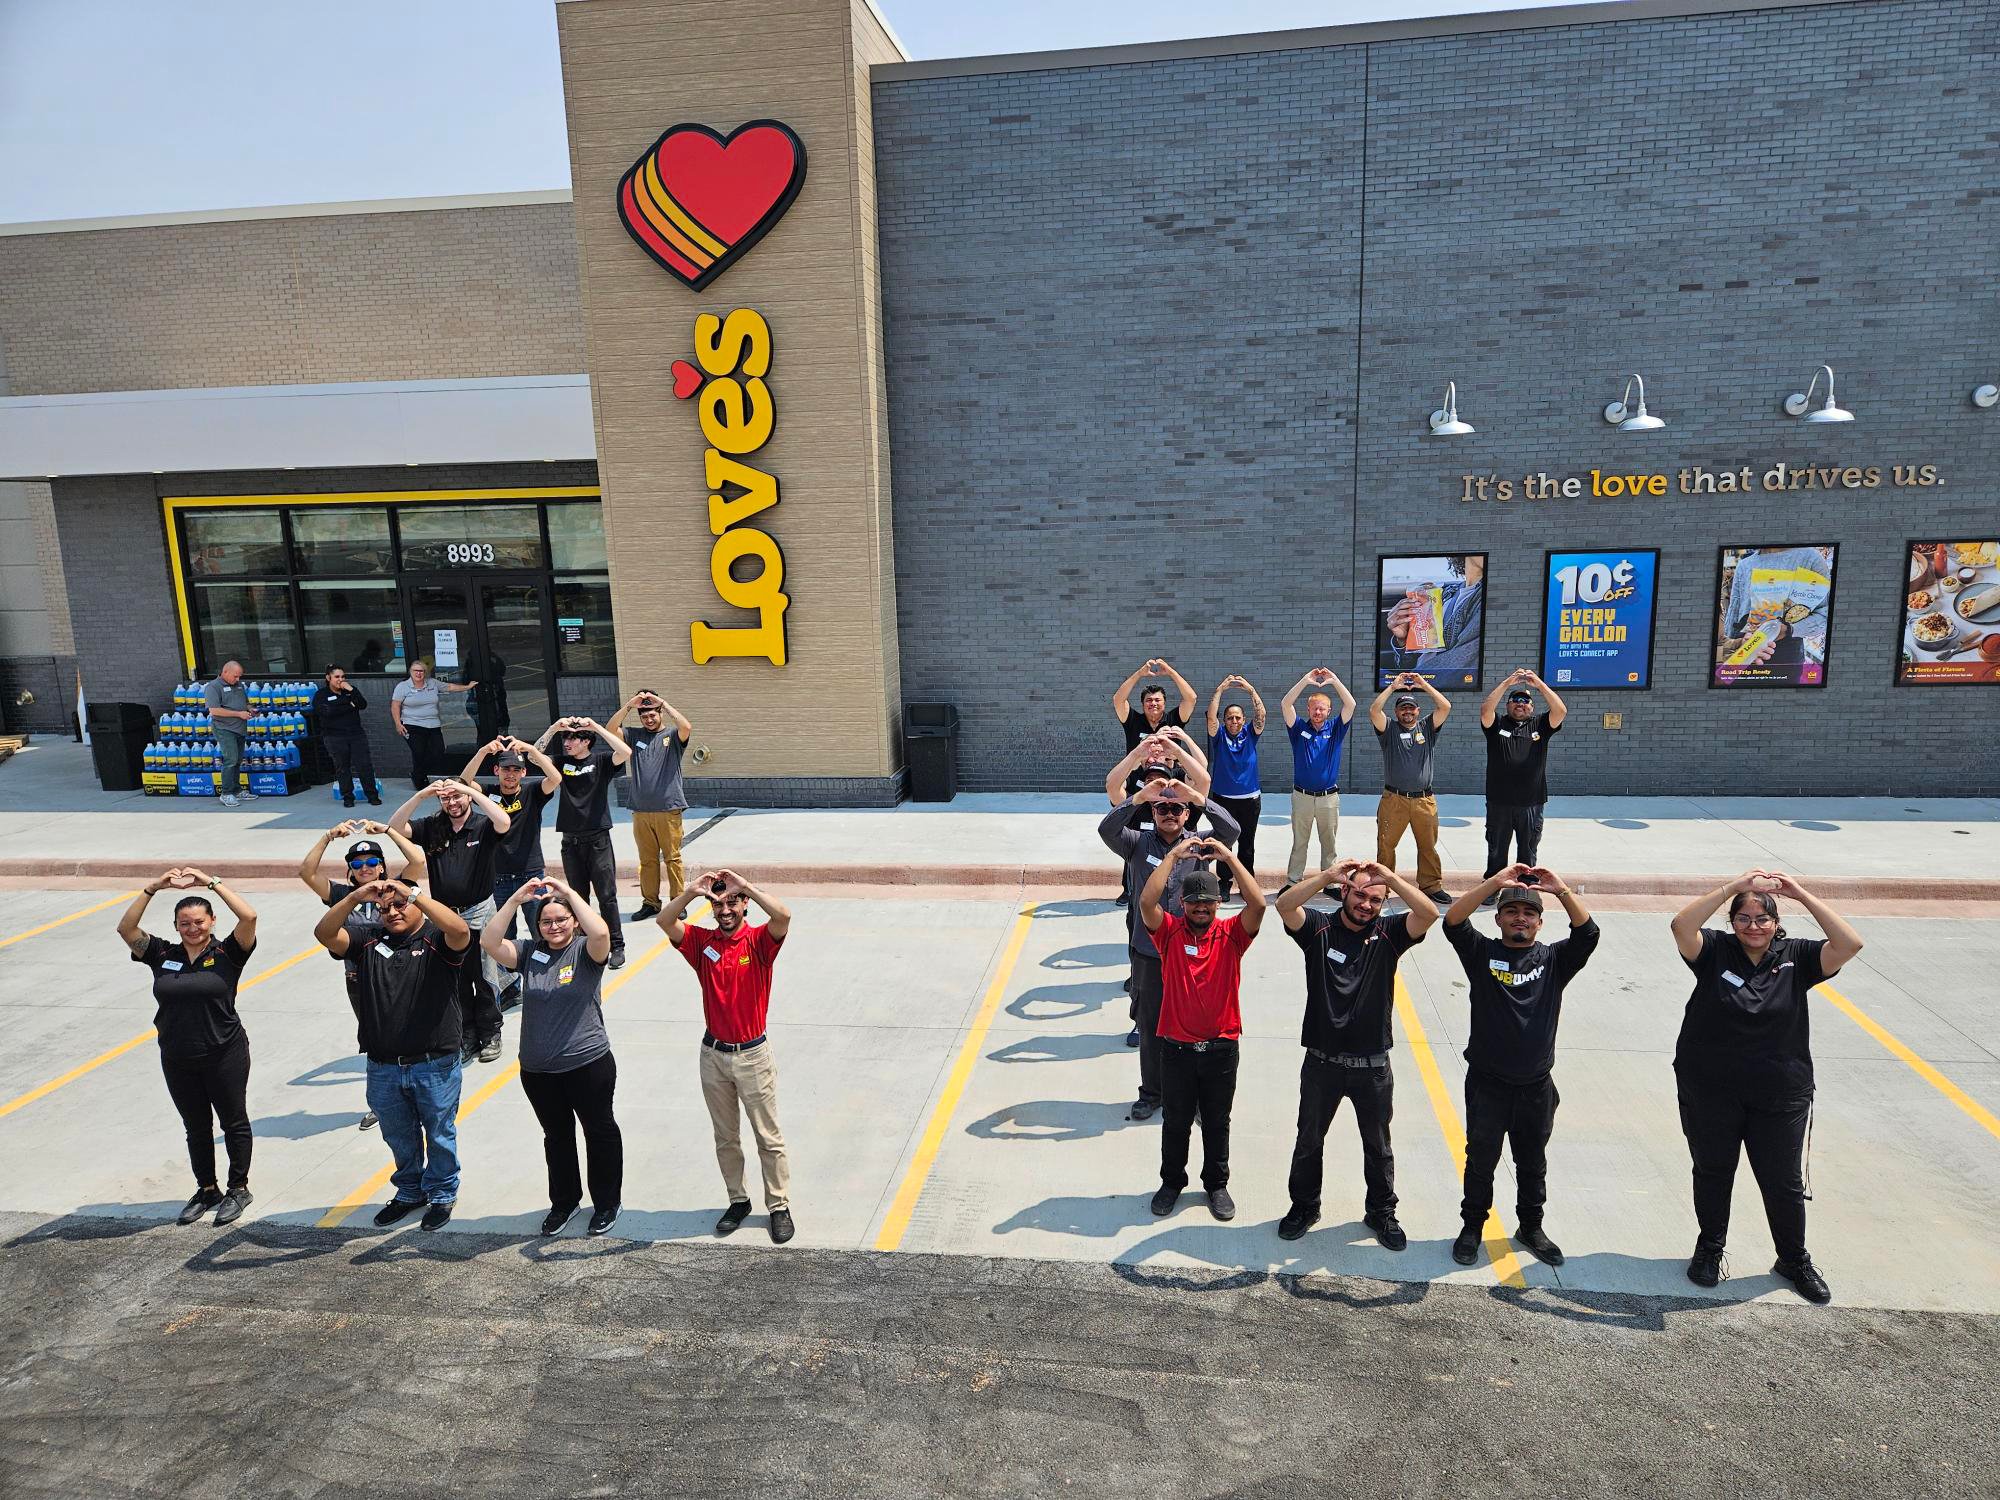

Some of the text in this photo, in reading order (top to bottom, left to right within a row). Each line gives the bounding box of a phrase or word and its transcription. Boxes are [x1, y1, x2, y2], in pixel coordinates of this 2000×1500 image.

[1461, 463, 1945, 501] It's the love that drives us.
[447, 543, 495, 563] 8993
[1603, 586, 1634, 602] OFF
[1560, 608, 1616, 625] EVERY
[1559, 625, 1627, 642] GALLON
[1606, 649, 1619, 657] APP
